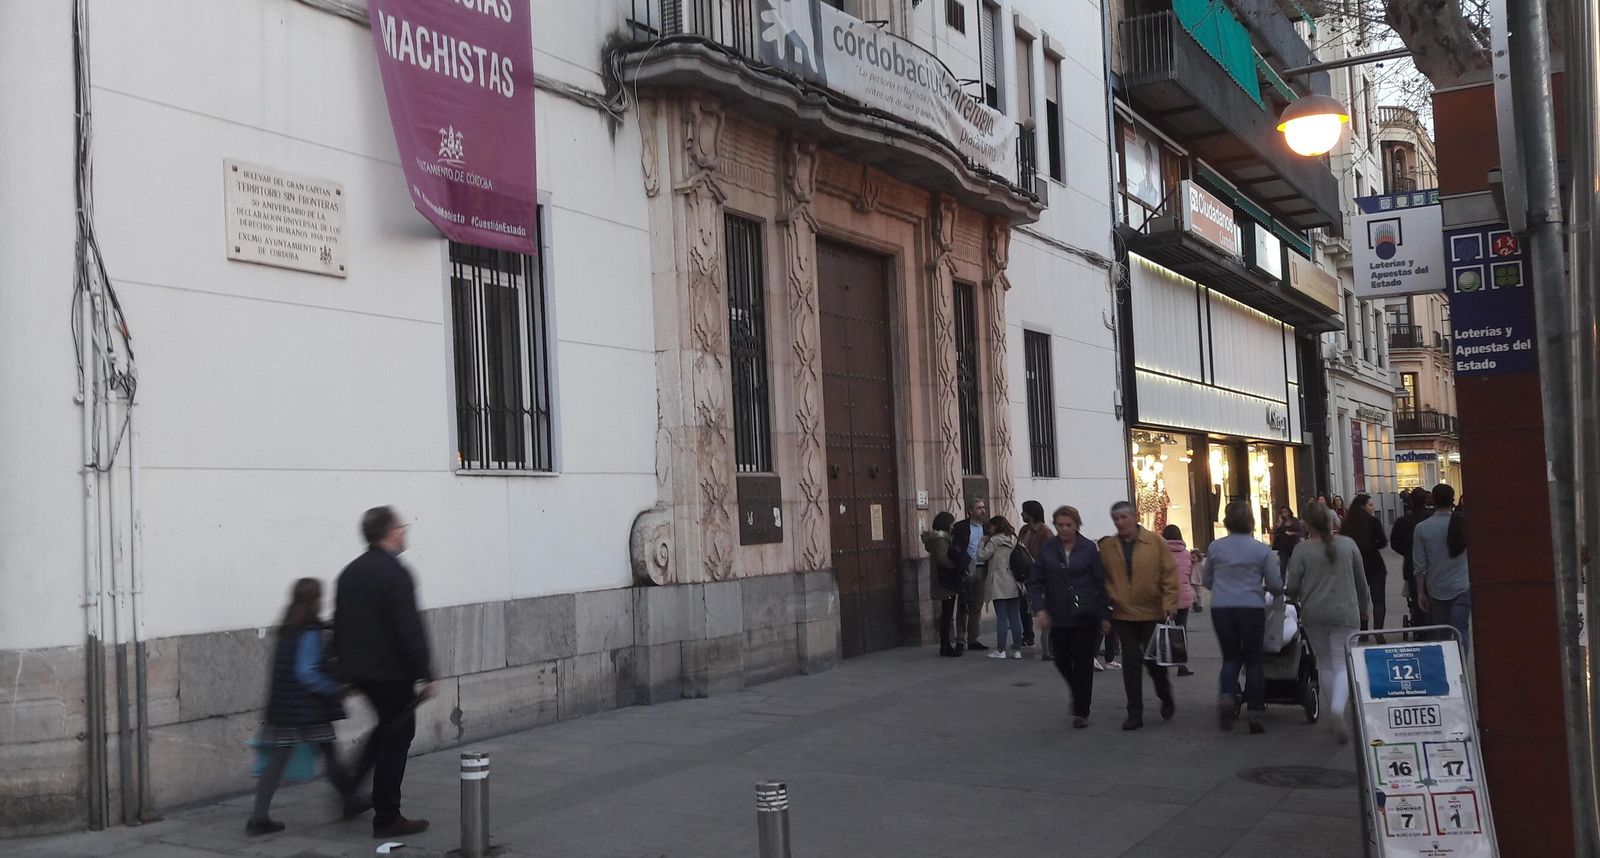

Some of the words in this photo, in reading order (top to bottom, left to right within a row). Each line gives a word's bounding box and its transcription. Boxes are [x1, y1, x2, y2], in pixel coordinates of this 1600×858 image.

[378, 9, 514, 98] MACHISTAS
[273, 177, 284, 186] DEL
[286, 180, 304, 190] GRAN
[454, 169, 464, 183] DE
[238, 181, 281, 199] TERRITORIO
[283, 192, 295, 202] SIN
[298, 194, 339, 211] FRONTERAS
[262, 201, 306, 216] ANIVERSARIO
[307, 210, 315, 218] DE
[317, 212, 326, 220] LA
[240, 218, 273, 232] DERECHOS
[275, 225, 308, 238] HUMANOS
[283, 216, 318, 230] UNIVERSAL
[320, 223, 327, 232] DE
[329, 225, 341, 234] LOS
[258, 246, 266, 255] DE
[264, 237, 317, 253] AYUNTAMIENTO
[1369, 259, 1406, 270] Loterías
[1408, 259, 1414, 268] y
[1371, 269, 1412, 281] Apuestas
[1415, 266, 1429, 275] del
[1371, 279, 1402, 289] Estado
[1454, 326, 1502, 340] Loterías
[1505, 325, 1513, 338] y
[1455, 342, 1509, 357] Apuestas
[1513, 339, 1531, 351] del
[1456, 358, 1497, 371] Estado
[1393, 706, 1436, 726] BOTES
[1388, 761, 1412, 776] 16
[1443, 760, 1464, 776] 17
[1401, 813, 1414, 828] 7
